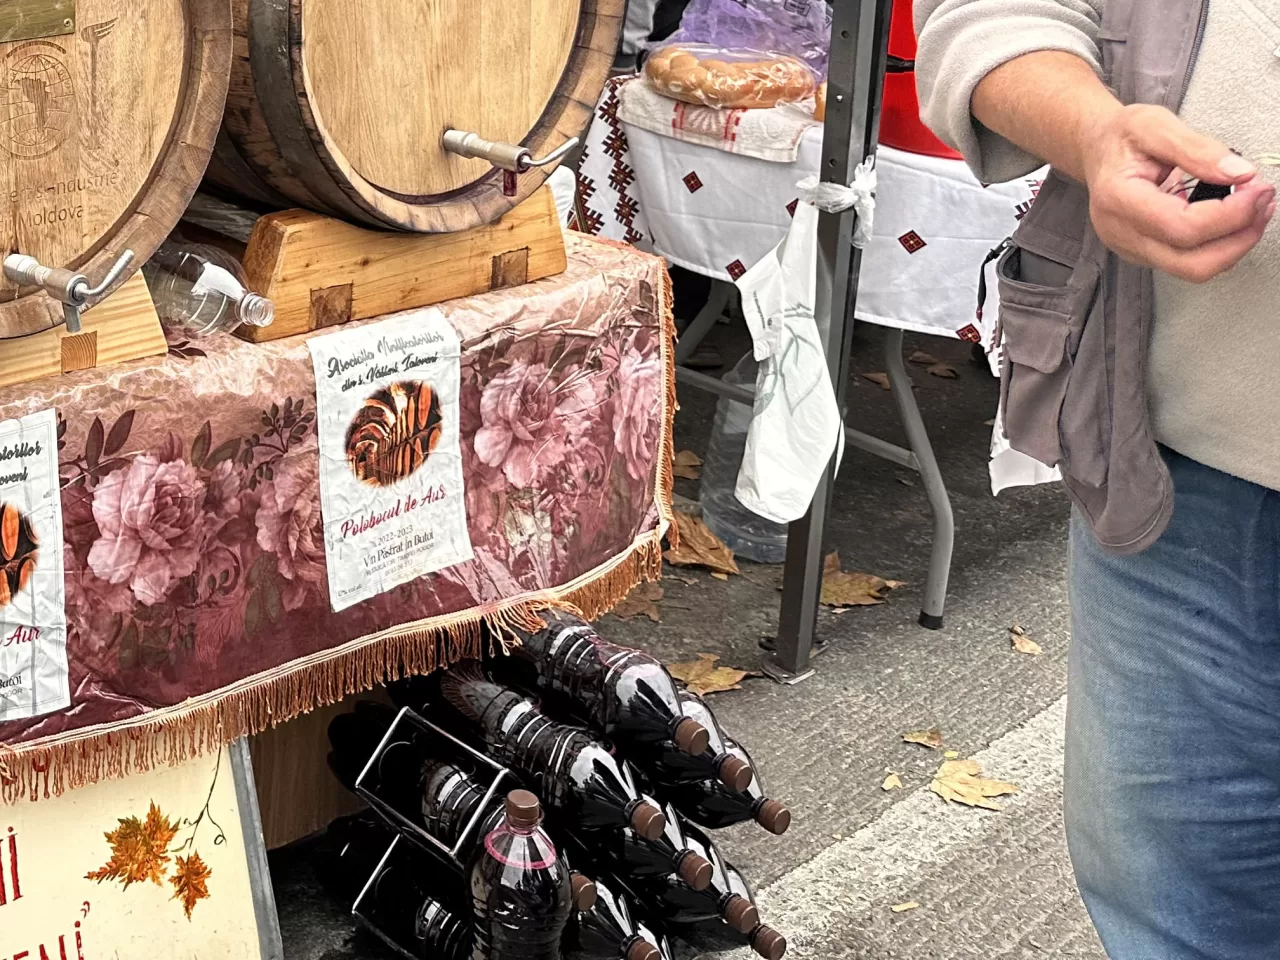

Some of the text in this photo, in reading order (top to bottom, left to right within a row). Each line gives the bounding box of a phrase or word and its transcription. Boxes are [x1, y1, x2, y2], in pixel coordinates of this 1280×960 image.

[340, 498, 401, 539] Polobocul
[404, 494, 417, 513] de
[414, 528, 434, 546] Butoi
[4, 625, 42, 647] Aur
